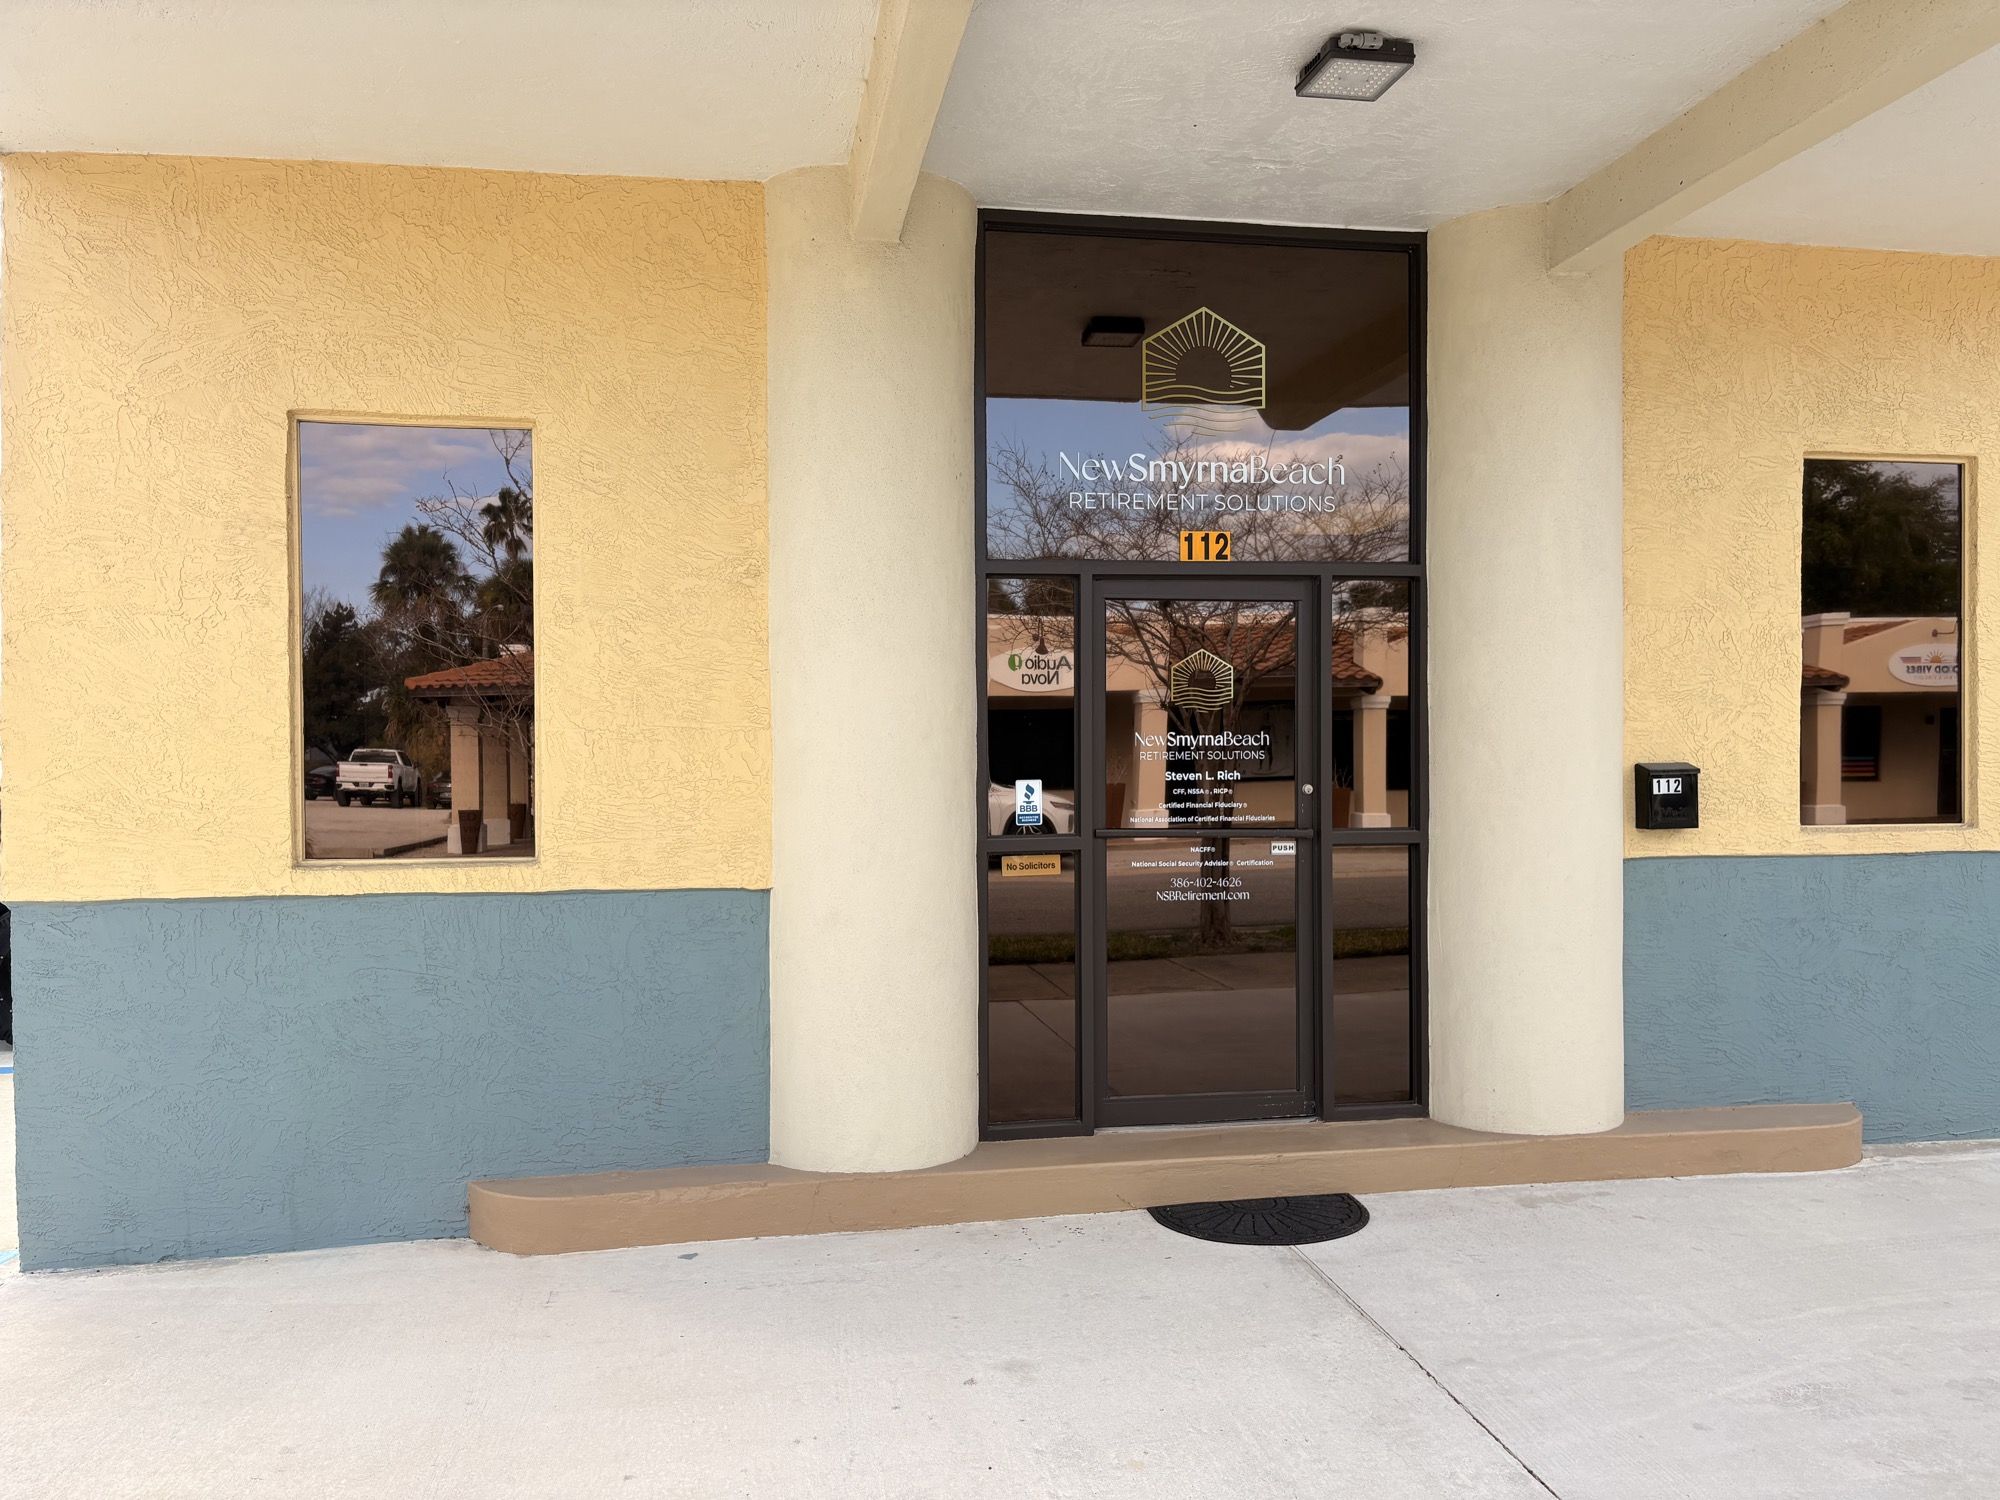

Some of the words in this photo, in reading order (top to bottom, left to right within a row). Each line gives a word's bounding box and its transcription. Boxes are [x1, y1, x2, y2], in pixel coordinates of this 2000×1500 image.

[1058, 451, 1345, 489] NewSmyrnaBeach
[1069, 492, 1208, 510] RETIREMENT
[1214, 493, 1336, 512] SOLUTIONS
[1183, 532, 1230, 560] 112
[1134, 731, 1270, 749] NewSmyrnaBeach
[1139, 751, 1204, 760] RETIREMENT
[1207, 750, 1266, 760] SOLUTIONS
[1165, 771, 1203, 781] Steven
[1205, 771, 1215, 780] L.
[1217, 770, 1241, 780] Rich
[1656, 779, 1681, 793] 112
[1172, 788, 1187, 796] CFF,
[1129, 816, 1154, 824] National
[1194, 815, 1218, 823] Certified
[1006, 862, 1017, 871] No
[1018, 862, 1056, 870] Solicitors
[1131, 860, 1157, 868] National
[1158, 860, 1177, 868] Social
[1177, 860, 1203, 868] Security
[1236, 859, 1274, 867] Certification
[1170, 876, 1242, 888] 386-402-4626
[1156, 890, 1250, 901] NSBRetirement.com
